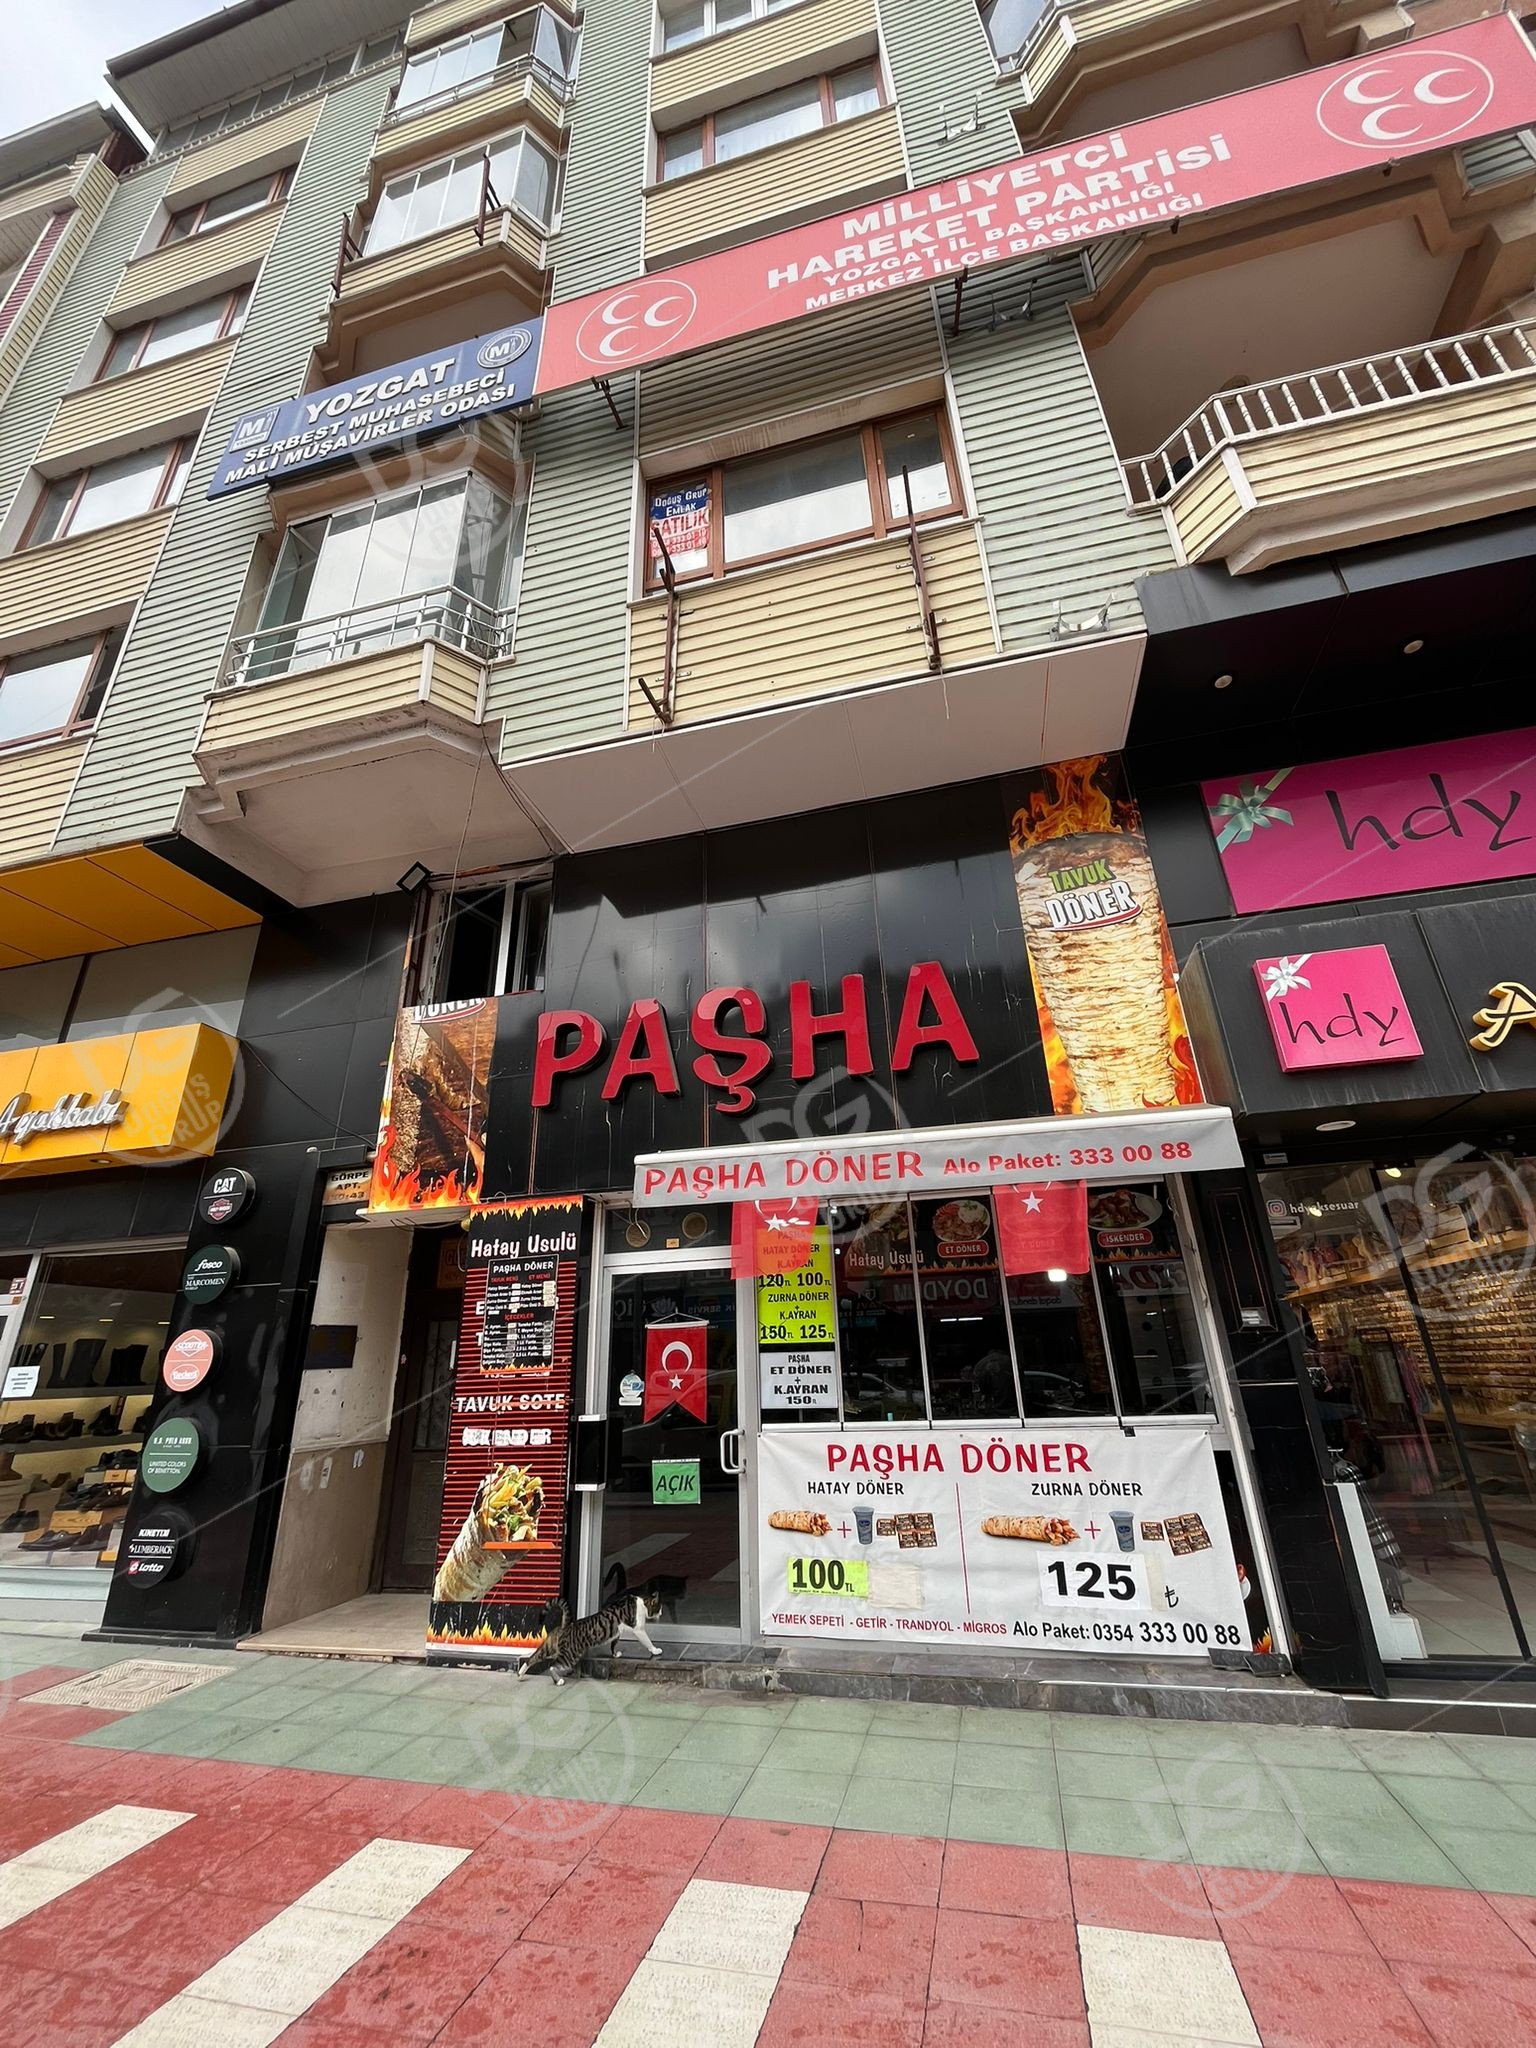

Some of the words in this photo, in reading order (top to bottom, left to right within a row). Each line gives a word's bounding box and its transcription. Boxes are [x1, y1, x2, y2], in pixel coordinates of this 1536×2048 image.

[843, 132, 1129, 240] MİLLİYETÇİ
[766, 202, 998, 290] HAREKET
[1015, 134, 1232, 217] PARTİSİ
[823, 244, 936, 288] YOZGAT
[949, 235, 977, 252] İL
[985, 181, 1174, 242] BAŞKANLIĞI
[804, 267, 927, 310] MERKEZ
[934, 245, 1001, 275] İLÇE
[1009, 192, 1203, 254] BAŞKANLIĞI
[305, 358, 456, 424] YOZGAT
[243, 418, 346, 463] SERBEST
[349, 367, 505, 428] MUHASEBECİ
[224, 453, 280, 485] MALİ
[284, 408, 433, 466] MÜŞAVİRLER
[440, 382, 515, 419] ODASI
[655, 494, 682, 507] DOĞUŞ
[685, 488, 707, 500] GRUP
[666, 503, 697, 517] EMLAK
[1325, 772, 1533, 851] hdy
[1048, 859, 1115, 892] TAVUK
[1045, 880, 1137, 929] DÖNER
[1278, 993, 1404, 1047] hdy
[531, 960, 980, 1114] PAŞHA
[331, 1170, 369, 1182] GÖRPE
[644, 1161, 766, 1198] PAŞHA
[785, 1150, 924, 1186] DÖNER
[943, 1158, 981, 1175] Alo
[988, 1151, 1061, 1171] Paket:
[1069, 1146, 1114, 1166] 333
[1122, 1143, 1153, 1163] 00
[1160, 1141, 1193, 1160] 88
[213, 1177, 237, 1194] CAT
[331, 1191, 365, 1200] O:43
[335, 1182, 361, 1191] APT.
[471, 1239, 520, 1259] Hatay
[527, 1231, 577, 1254] Usulü
[945, 1245, 957, 1254] ET
[959, 1243, 982, 1253] DÖNER
[1105, 1232, 1145, 1244] İSKENDER
[194, 1259, 223, 1272] fosco
[493, 1264, 521, 1274] PAŞHA
[524, 1260, 554, 1271] DÖNER
[849, 1252, 884, 1269] Hatay
[889, 1248, 924, 1266] Usuü
[768, 1294, 797, 1303] ZURNA
[799, 1291, 829, 1301] DÖNER
[779, 1310, 816, 1320] K.AYRAN
[770, 1366, 785, 1375] ET
[788, 1364, 832, 1375] DÖNER
[788, 1354, 810, 1364] PAŞHA
[774, 1384, 828, 1395] K.AYRAN
[456, 1395, 513, 1412] TAVUK
[519, 1393, 565, 1410] SOTE
[827, 1443, 944, 1480] PAŞHA
[960, 1437, 1092, 1474] DÖNER
[656, 1474, 696, 1498] AÇIK
[808, 1482, 850, 1494] HATAY
[856, 1479, 904, 1495] DÖNER
[1031, 1482, 1083, 1496] ZURNA
[1088, 1479, 1143, 1496] DÖNER
[1047, 1560, 1136, 1600] 125
[771, 1613, 807, 1625] YEMEK
[809, 1613, 844, 1627] SEPETİ
[856, 1615, 887, 1628] GETİR
[896, 1619, 954, 1631] TRANDYOL
[963, 1620, 1007, 1634] MİGROS
[1013, 1621, 1038, 1637] Alo
[1042, 1622, 1090, 1640] Paket:
[1093, 1624, 1133, 1642] 0354
[1138, 1622, 1177, 1643] 333
[1182, 1623, 1208, 1644] 00
[1214, 1624, 1241, 1645] 88
